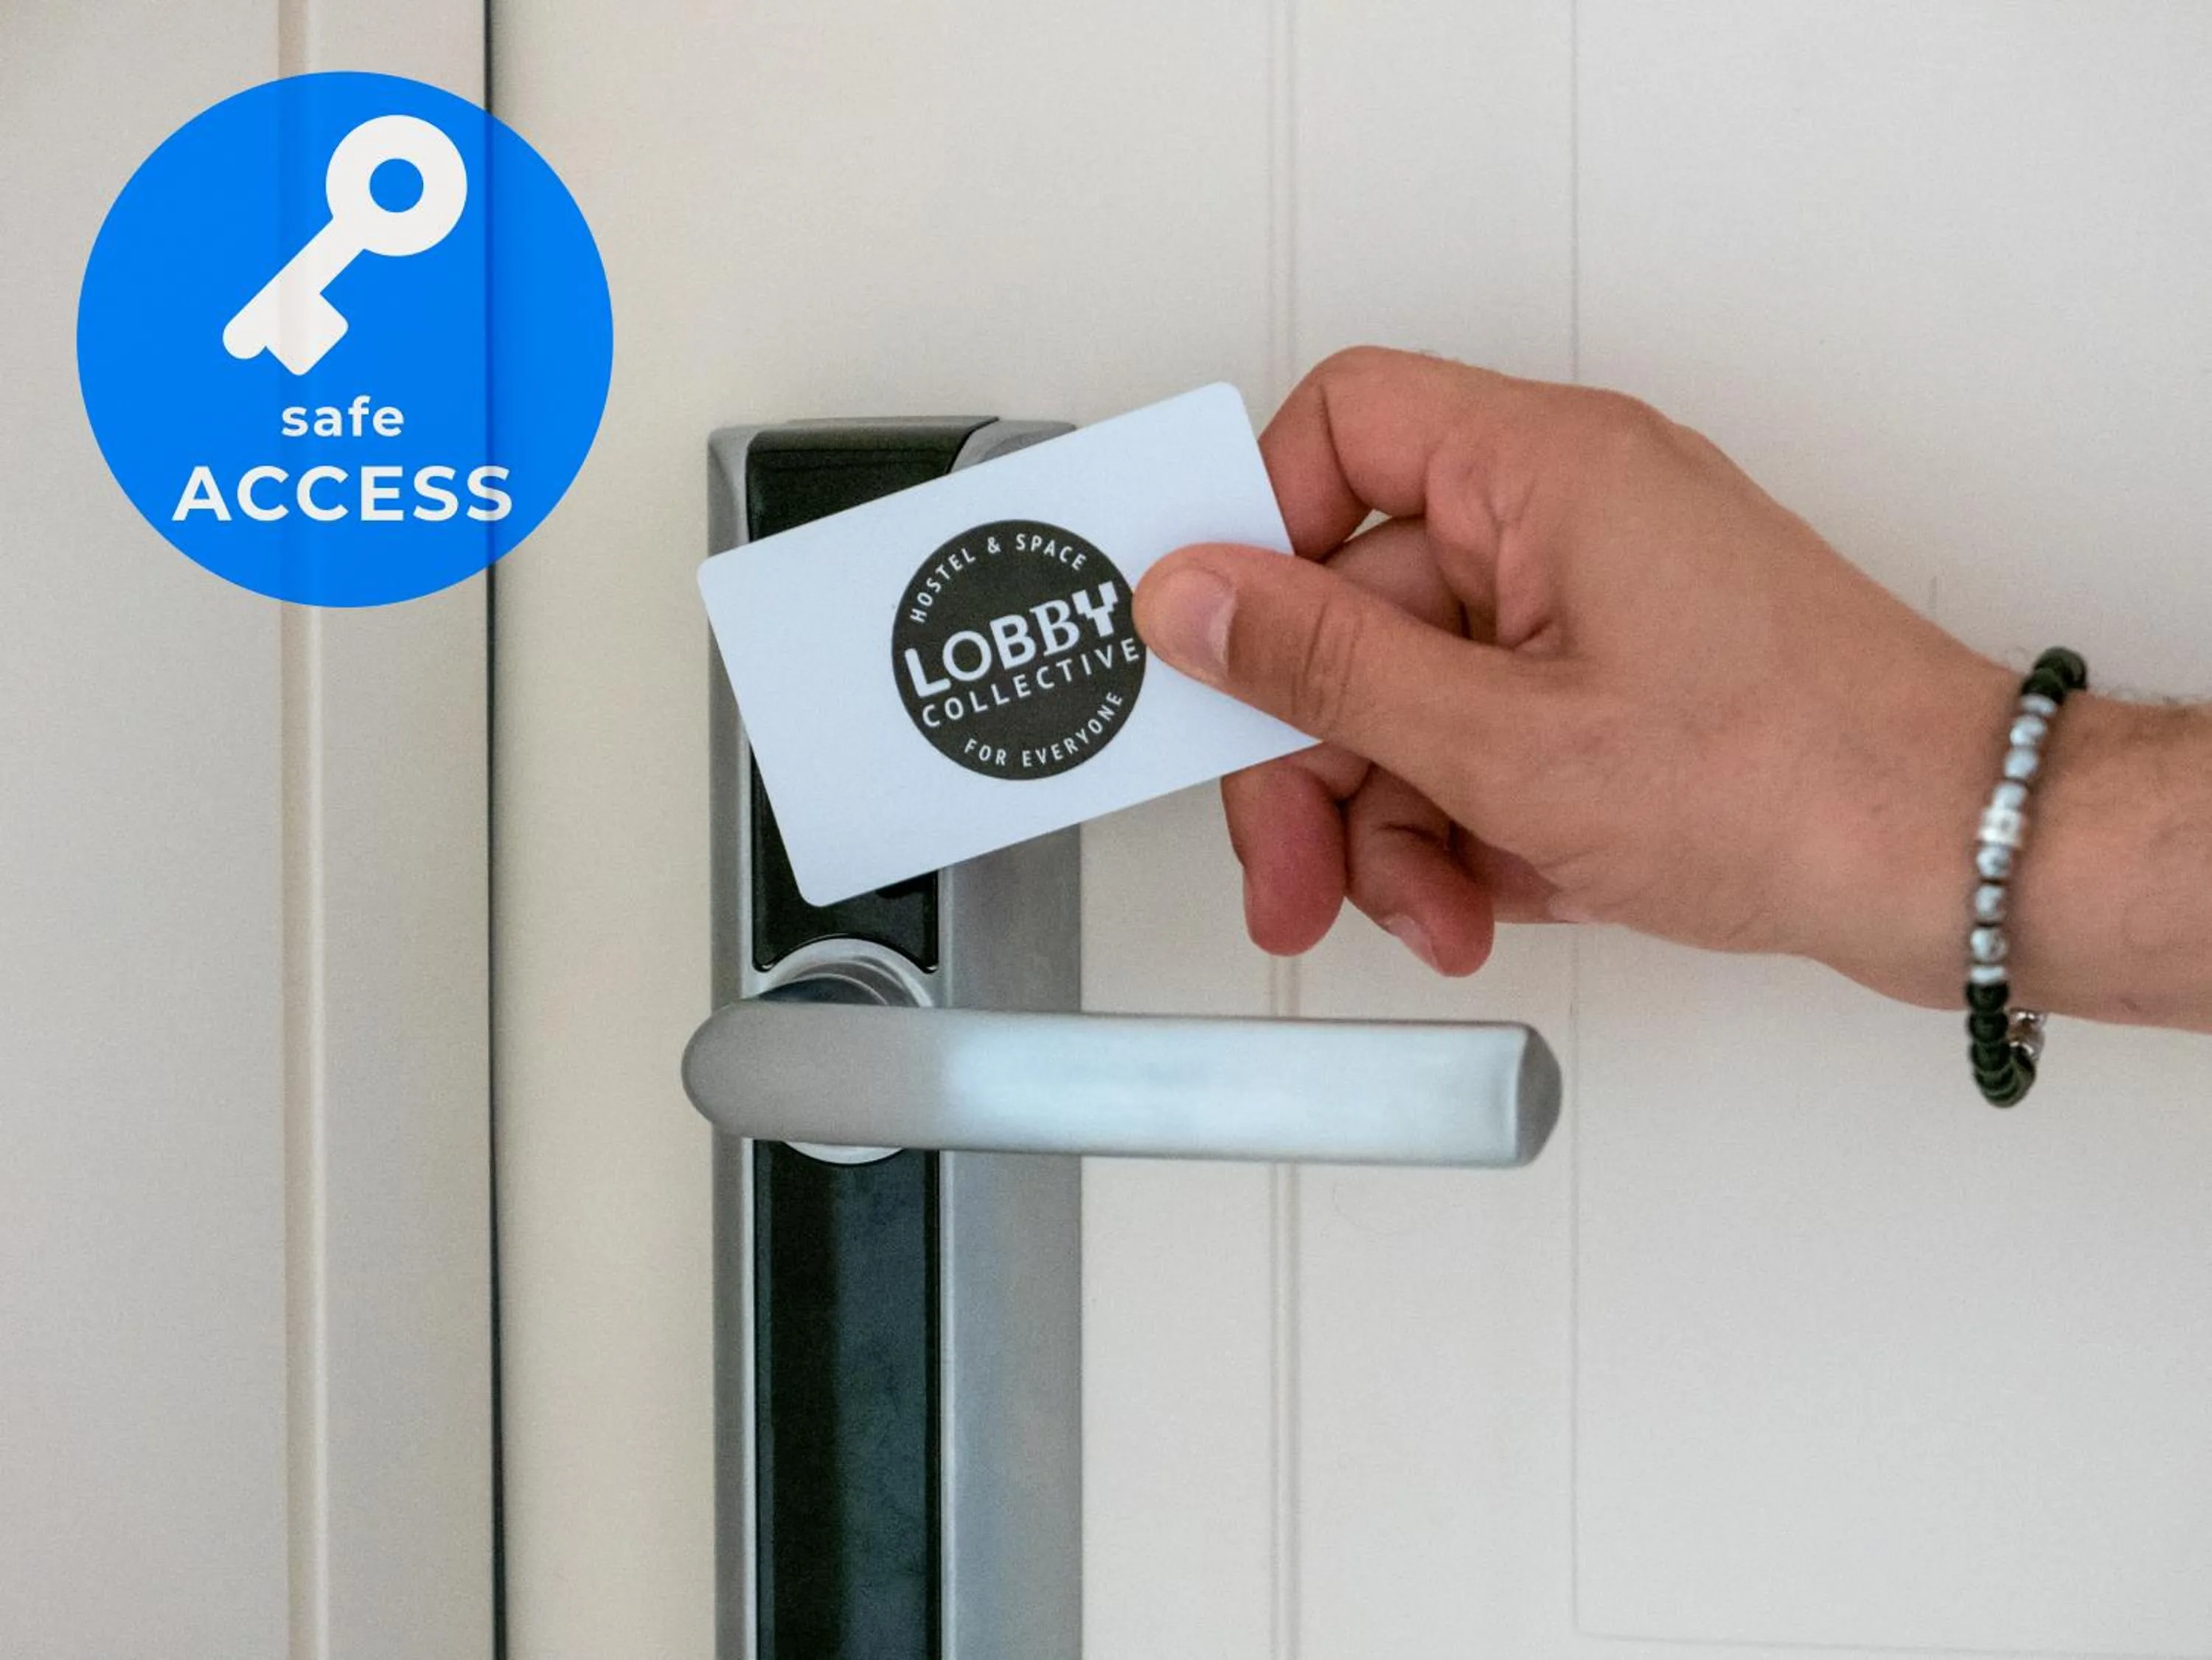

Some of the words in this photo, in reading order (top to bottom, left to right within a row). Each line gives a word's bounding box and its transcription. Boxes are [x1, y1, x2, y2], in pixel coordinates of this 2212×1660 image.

[910, 548, 976, 624] HOSTEL
[987, 537, 1001, 554] &
[1016, 534, 1086, 571] SPACE
[904, 580, 1119, 697] LOBBY
[922, 638, 1139, 728] COLLECTIVE
[964, 739, 1006, 766] FOR
[1022, 691, 1123, 767] EVERYONE
